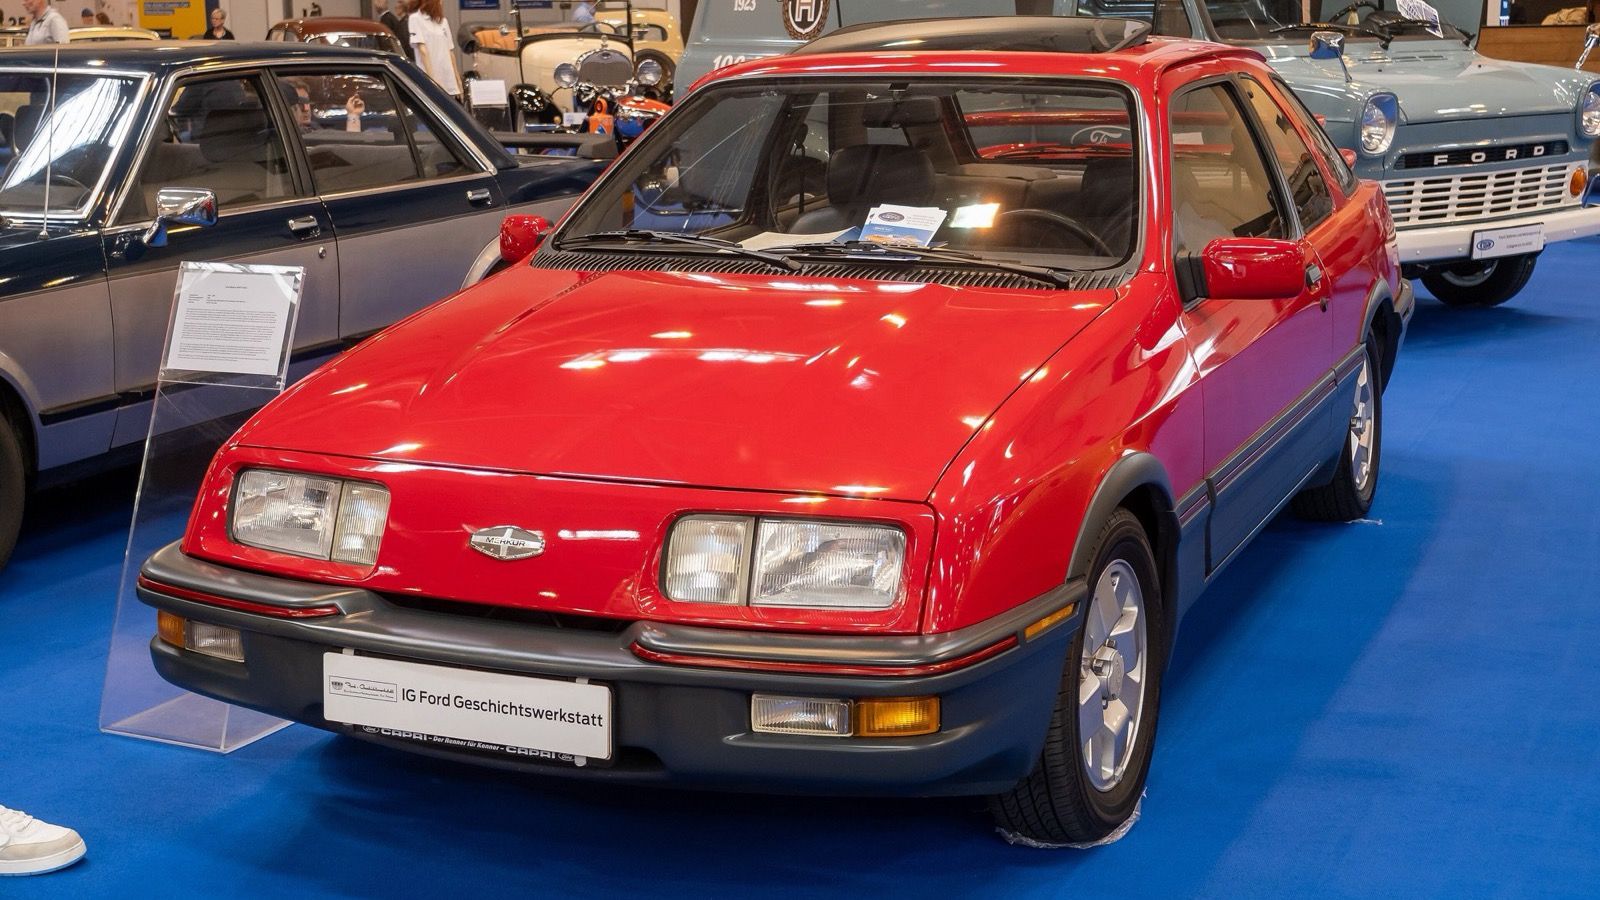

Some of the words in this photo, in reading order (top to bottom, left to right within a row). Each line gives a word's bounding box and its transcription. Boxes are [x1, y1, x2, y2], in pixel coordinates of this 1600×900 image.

[1433, 145, 1545, 166] FORD
[485, 537, 525, 546] MERKUR
[402, 688, 416, 702] IG
[419, 690, 450, 707] Ford
[453, 695, 603, 728] Geschichtswerkstatt
[433, 736, 444, 744] Der
[444, 738, 467, 747] Renner
[477, 743, 500, 752] Kenner
